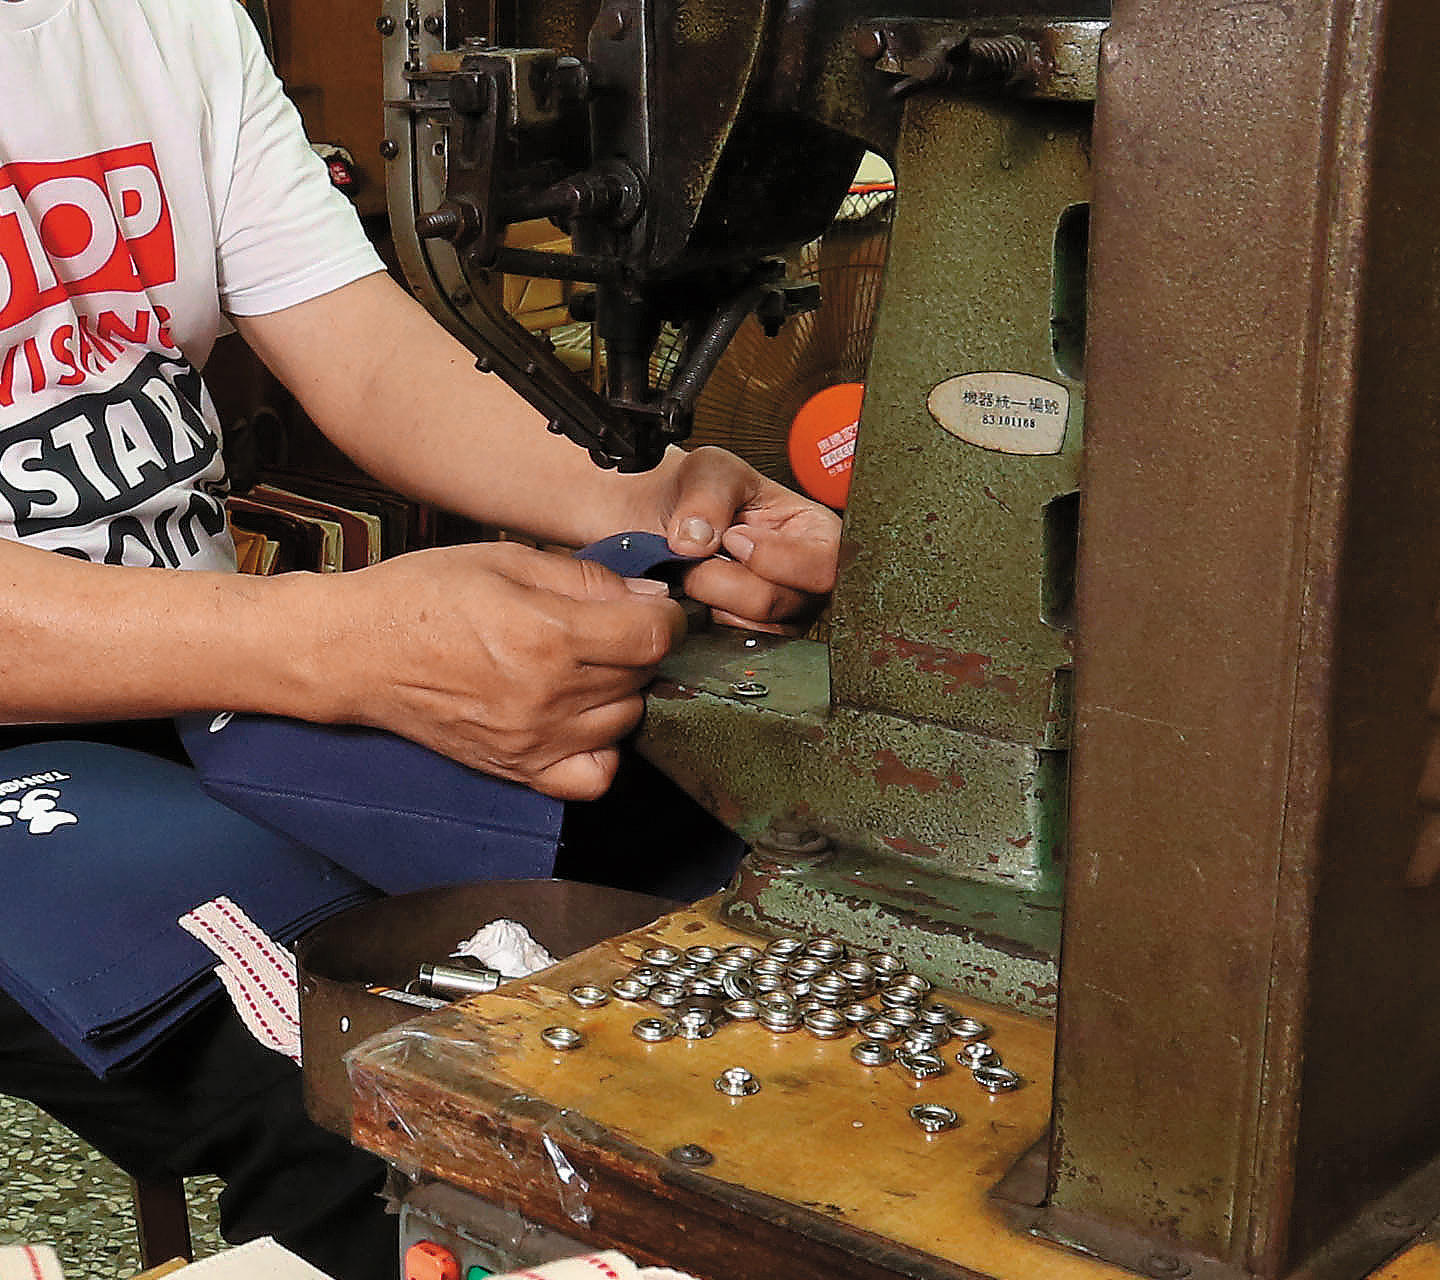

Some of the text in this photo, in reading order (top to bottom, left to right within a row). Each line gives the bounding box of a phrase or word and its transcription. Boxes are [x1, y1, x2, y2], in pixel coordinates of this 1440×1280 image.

[963, 391, 1060, 415] 機器統一編號
